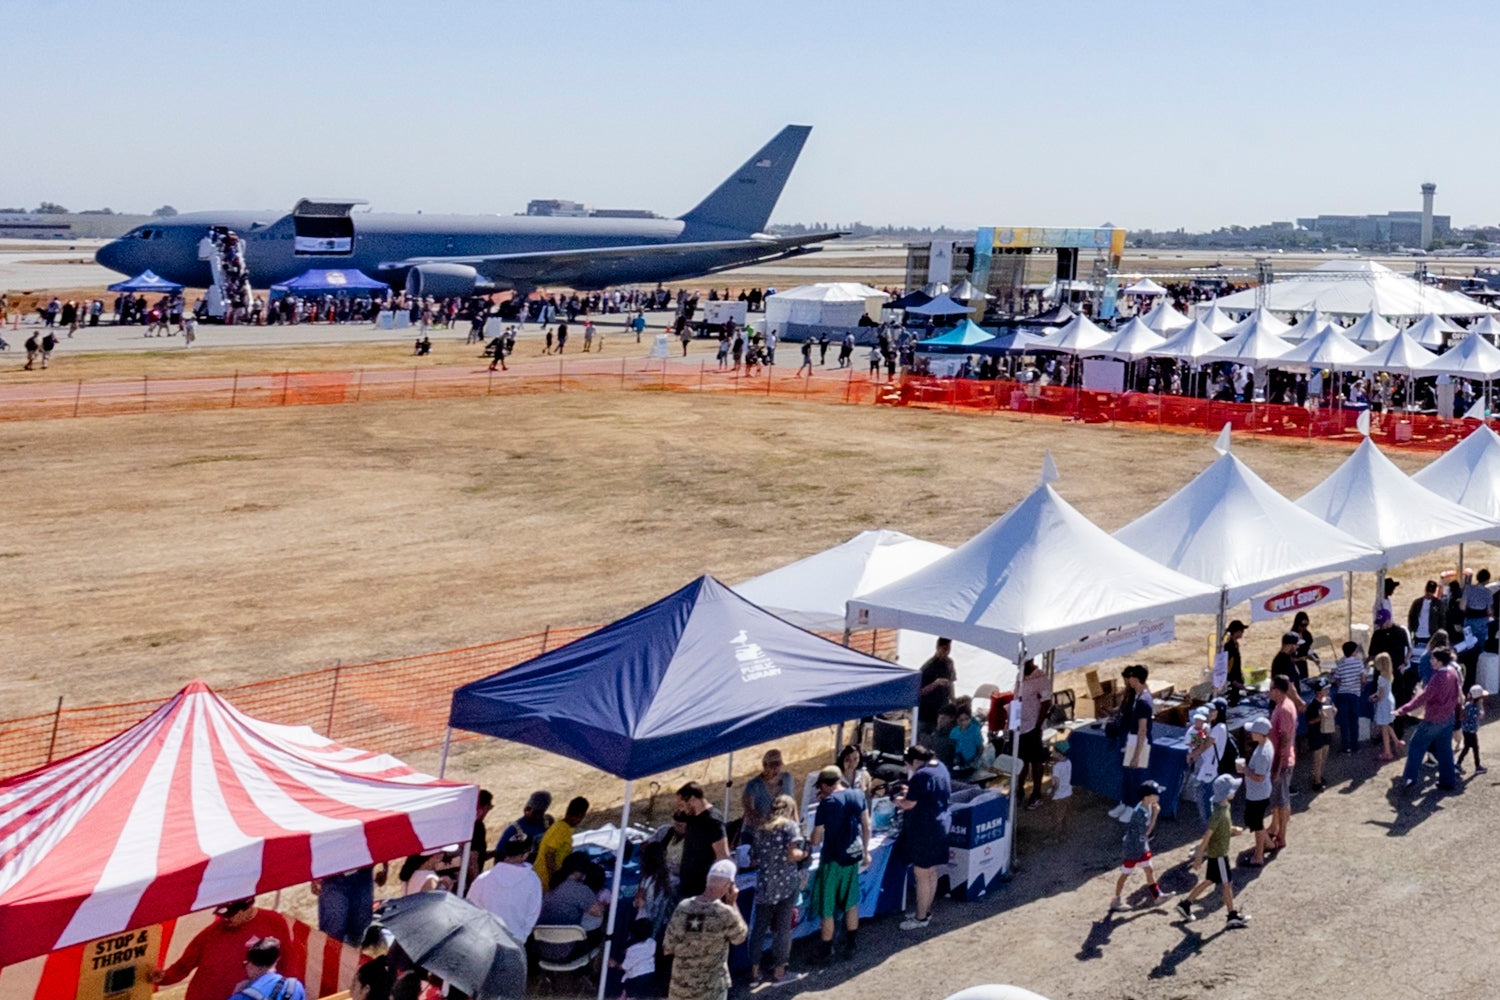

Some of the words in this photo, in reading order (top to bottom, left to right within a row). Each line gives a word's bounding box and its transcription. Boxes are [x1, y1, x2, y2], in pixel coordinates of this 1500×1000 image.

[742, 668, 782, 682] LIBRARY
[976, 817, 1003, 834] TRASH
[96, 934, 134, 954] STOP
[137, 929, 148, 944] &
[92, 945, 148, 970] THROW
